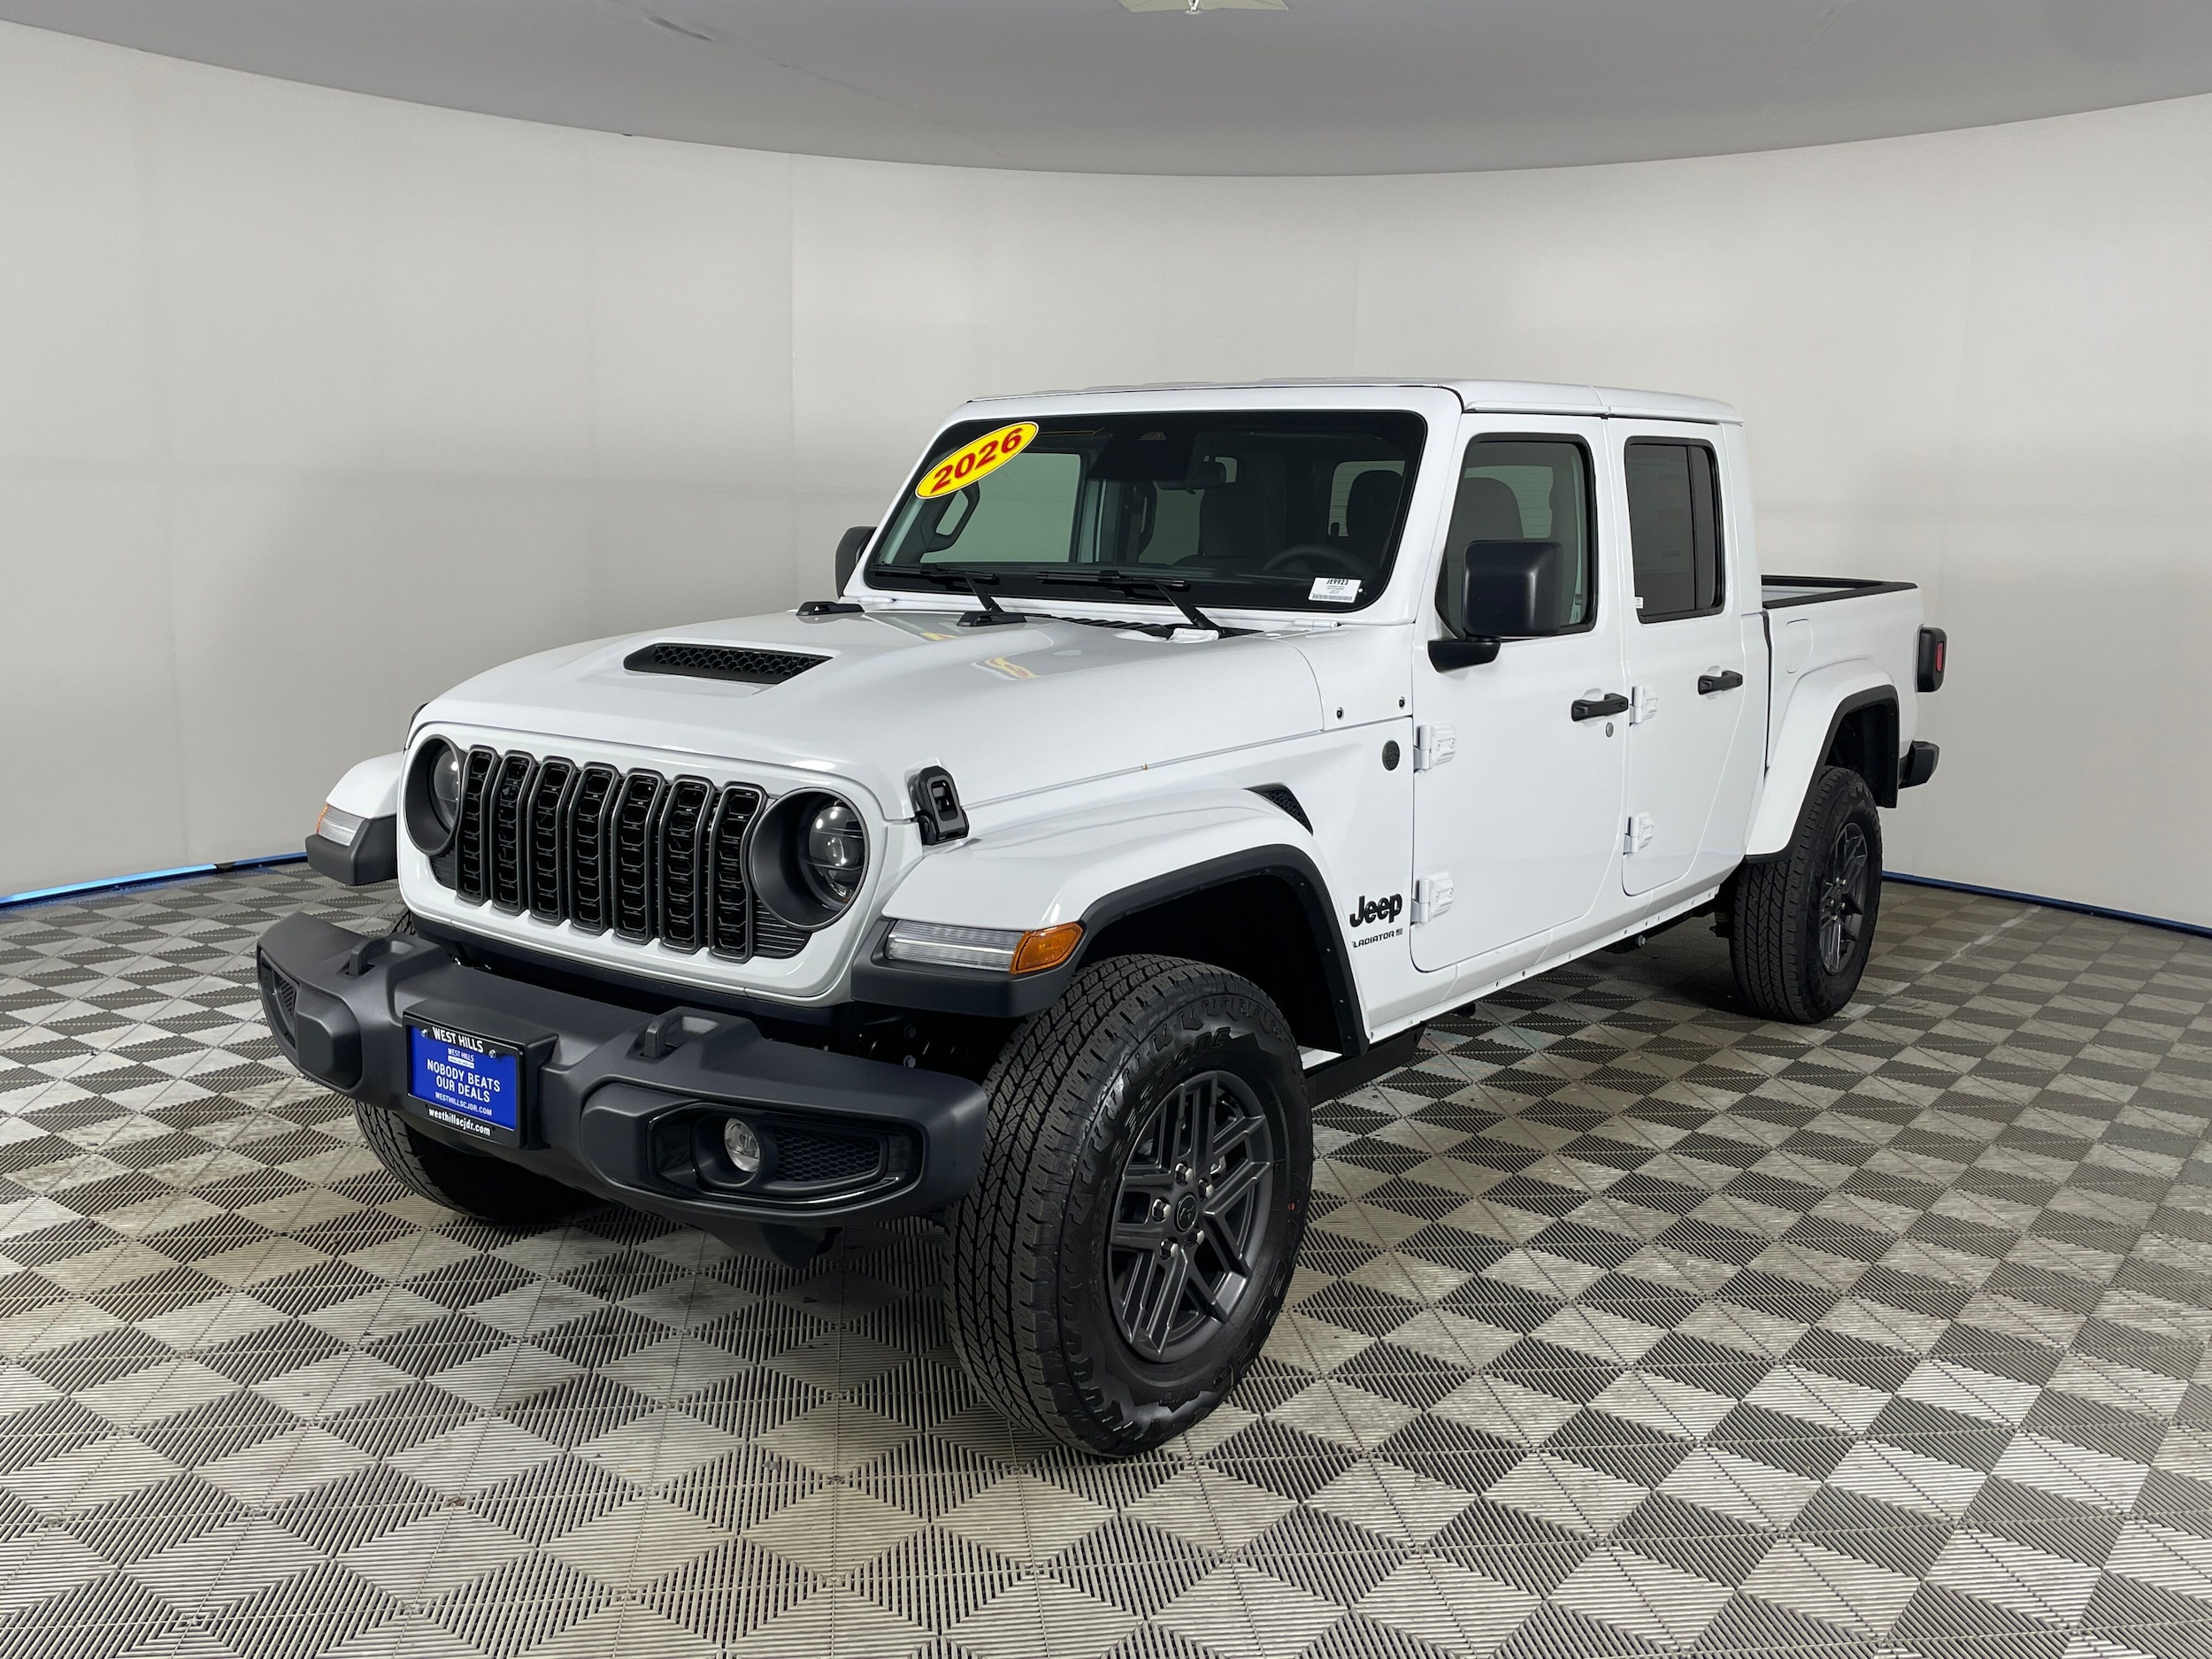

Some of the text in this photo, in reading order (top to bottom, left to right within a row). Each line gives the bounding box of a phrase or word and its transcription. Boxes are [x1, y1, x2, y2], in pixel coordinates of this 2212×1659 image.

[930, 427, 1024, 494] 2026
[1349, 893, 1402, 927] Jeep
[432, 1026, 484, 1053] WEST HILLS
[448, 1048, 461, 1057] WEST
[461, 1051, 474, 1063] HILLS
[426, 1058, 465, 1081] NOBODY
[468, 1071, 501, 1093] BEATS
[436, 1075, 490, 1102] OUR DEALS
[434, 1091, 493, 1116] WESTHILLSCJDR.COM
[428, 1108, 491, 1136] westhillscjdr.com
